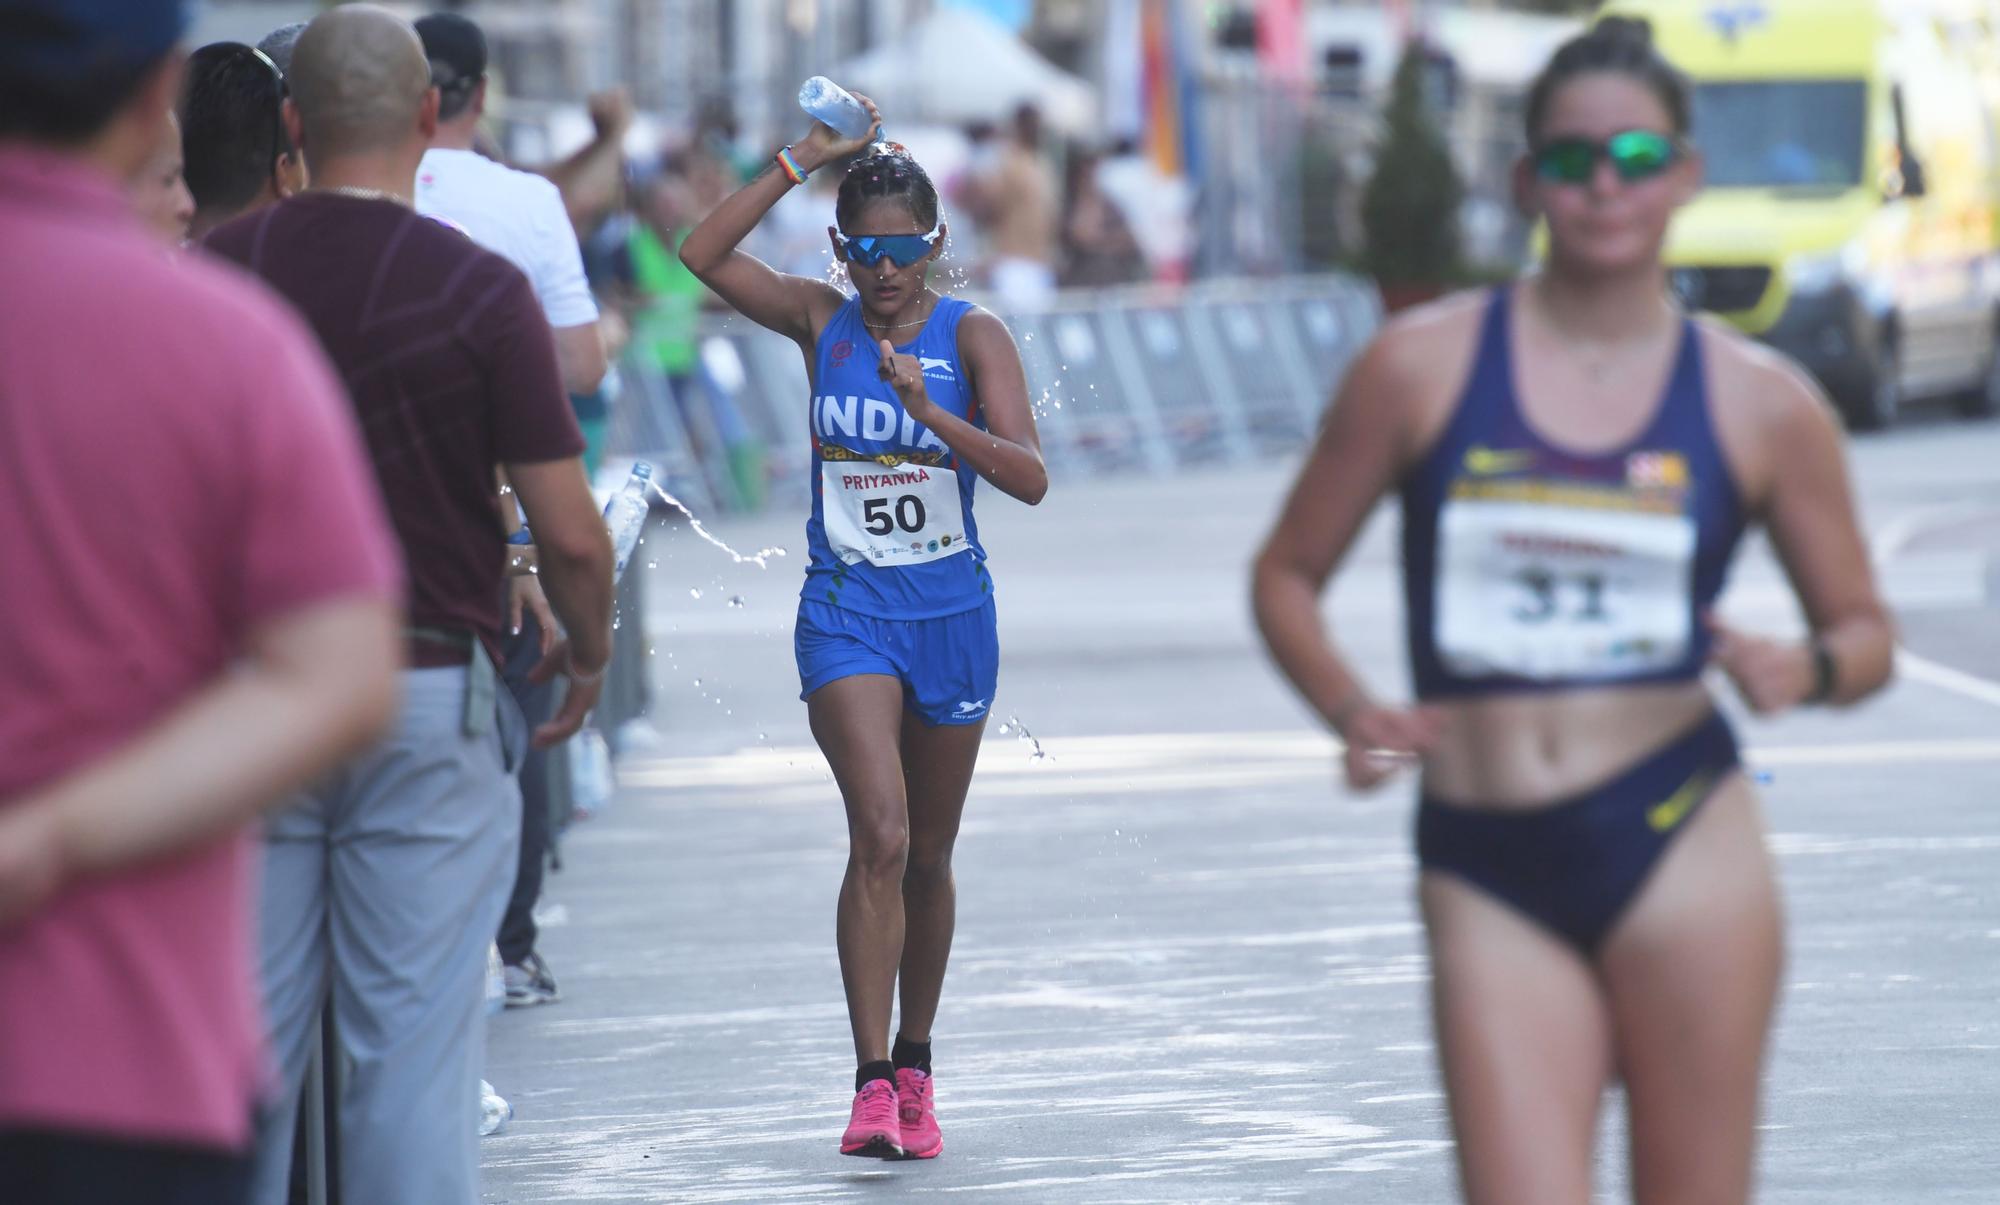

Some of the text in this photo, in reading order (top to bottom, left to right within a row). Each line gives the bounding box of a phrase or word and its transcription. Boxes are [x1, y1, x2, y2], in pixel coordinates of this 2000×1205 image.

[842, 468, 930, 490] PRIYANKA
[863, 494, 926, 536] 50
[1508, 566, 1612, 623] 31
